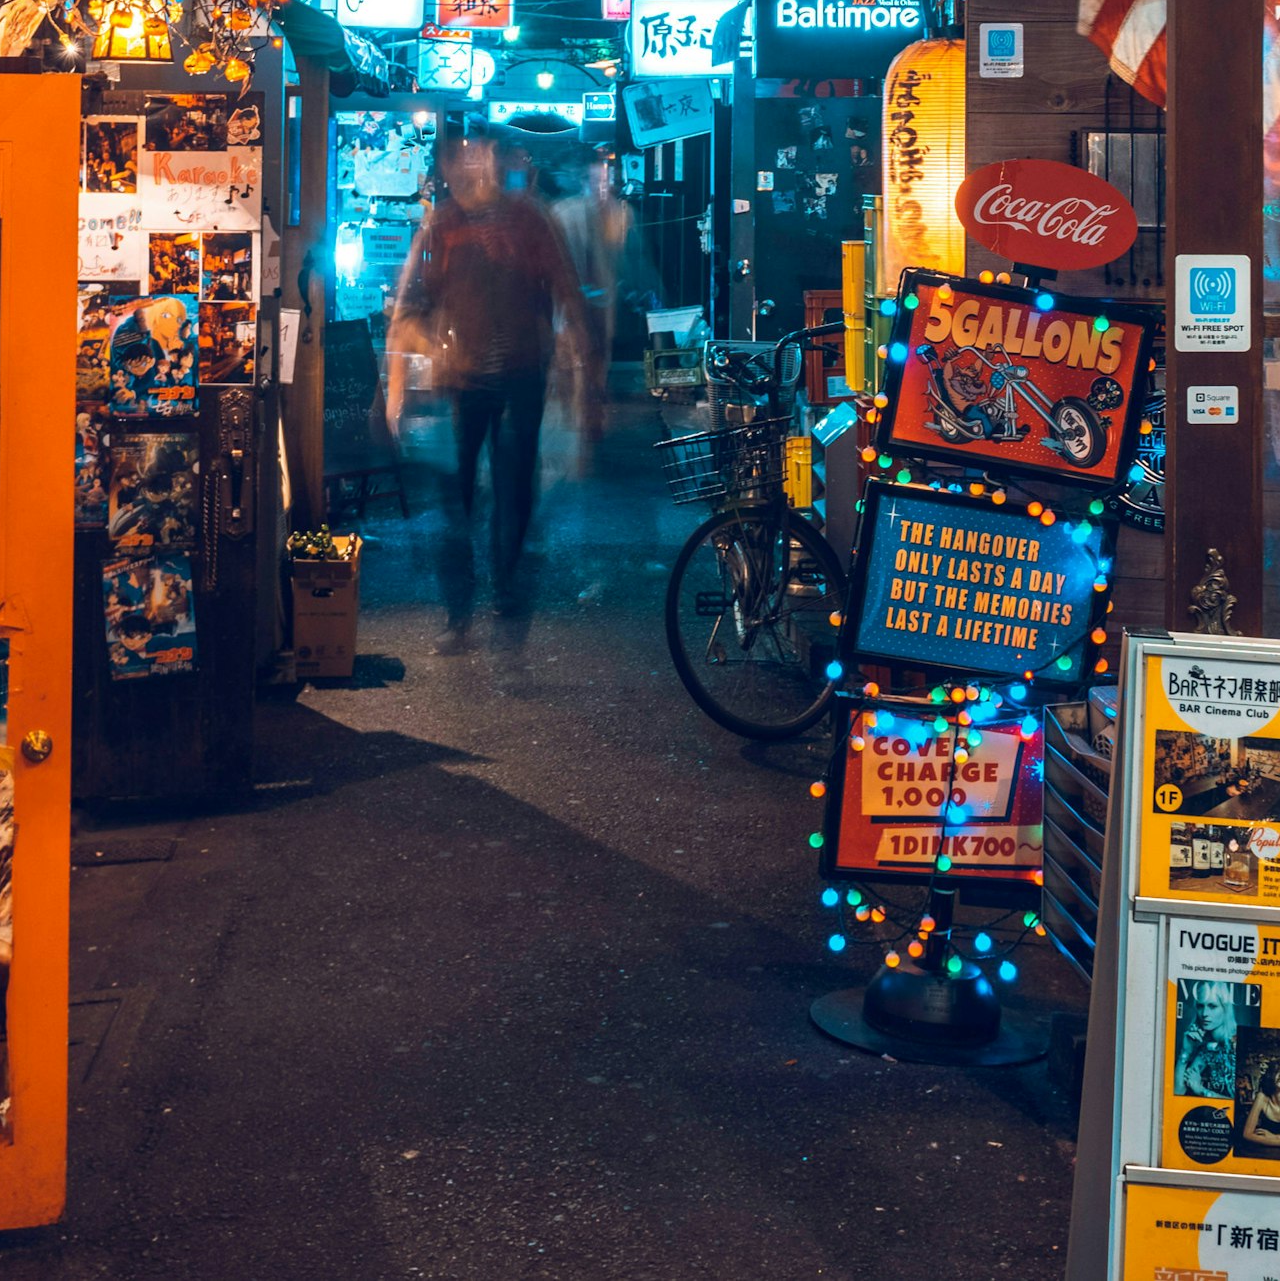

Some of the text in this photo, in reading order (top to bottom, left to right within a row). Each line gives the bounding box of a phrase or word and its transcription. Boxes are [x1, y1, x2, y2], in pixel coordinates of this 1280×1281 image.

[153, 153, 258, 186] Karaoke
[974, 184, 1119, 247] Coca-Cola
[1200, 301, 1226, 311] Wi-Fi
[1207, 394, 1231, 402] Square
[900, 519, 1041, 563] THE HANGOVER
[894, 548, 1067, 596] ONLY LASTS A DAY
[890, 577, 1074, 627] BUT THE MEMORIES
[885, 606, 1039, 650] LAST A LIFETIME
[1179, 703, 1270, 719] BAR Cinema Club
[877, 761, 999, 783] CHARGE
[882, 786, 967, 808] 1,000
[1159, 790, 1179, 805] 1F
